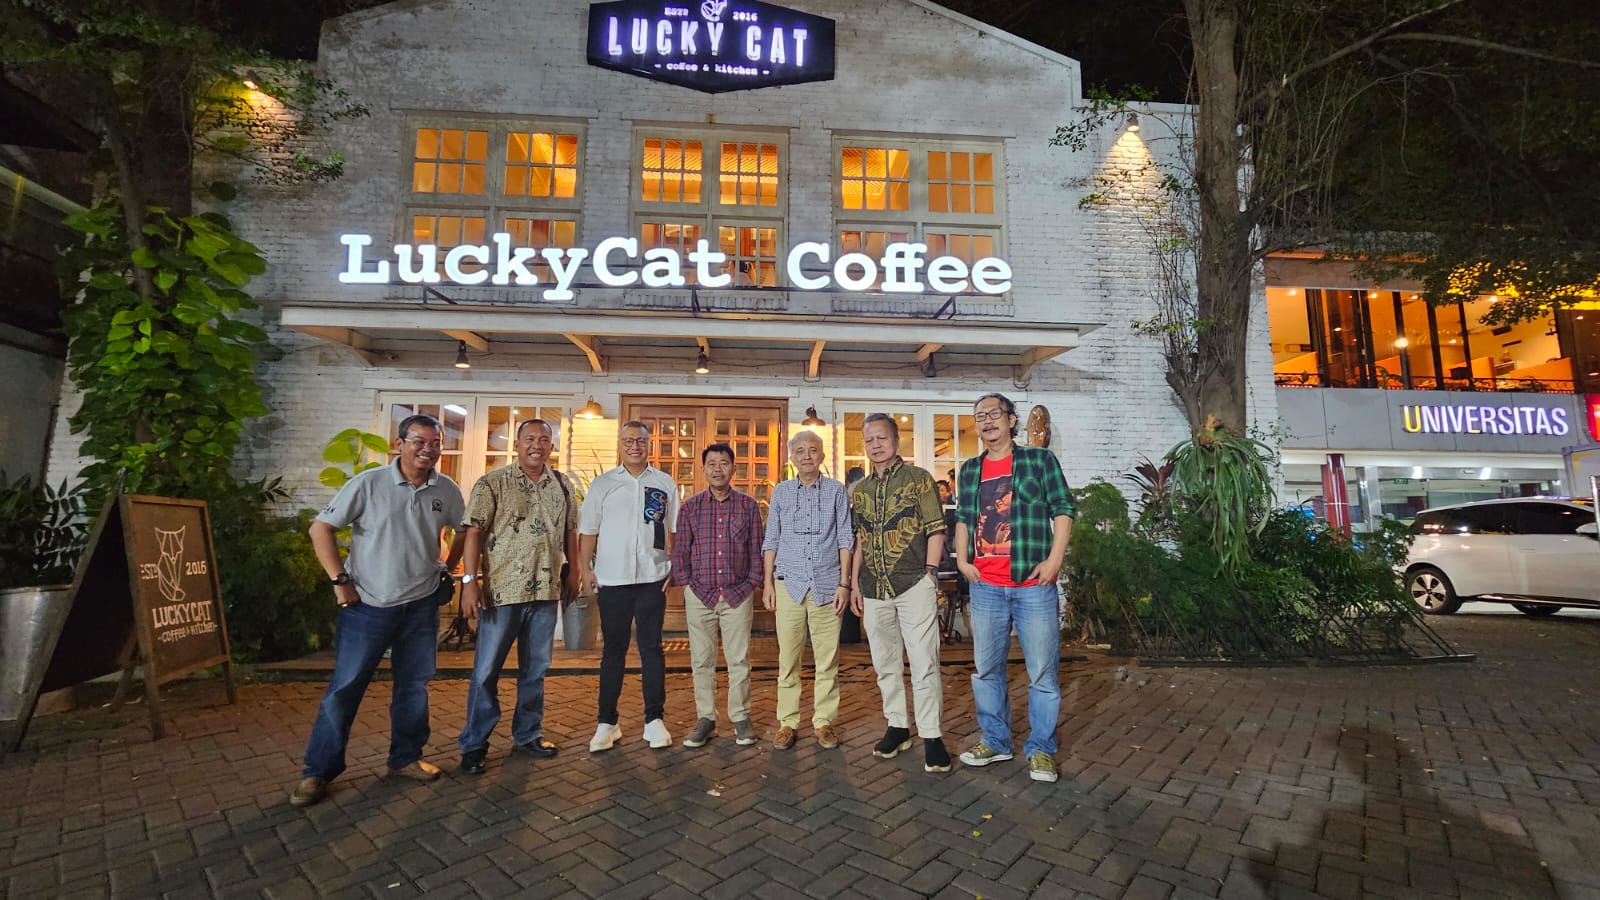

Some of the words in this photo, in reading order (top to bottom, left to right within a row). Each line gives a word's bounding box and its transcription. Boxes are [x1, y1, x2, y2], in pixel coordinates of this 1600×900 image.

[732, 11, 758, 21] 2016
[608, 16, 724, 56] LUCKY
[746, 25, 808, 67] CAT
[666, 62, 698, 71] coffee
[715, 63, 758, 75] kitchen
[337, 232, 732, 301] LuckyCat
[786, 241, 1013, 294] Coffee
[1403, 405, 1569, 436] UNIVERSITAS
[185, 560, 207, 576] 2016
